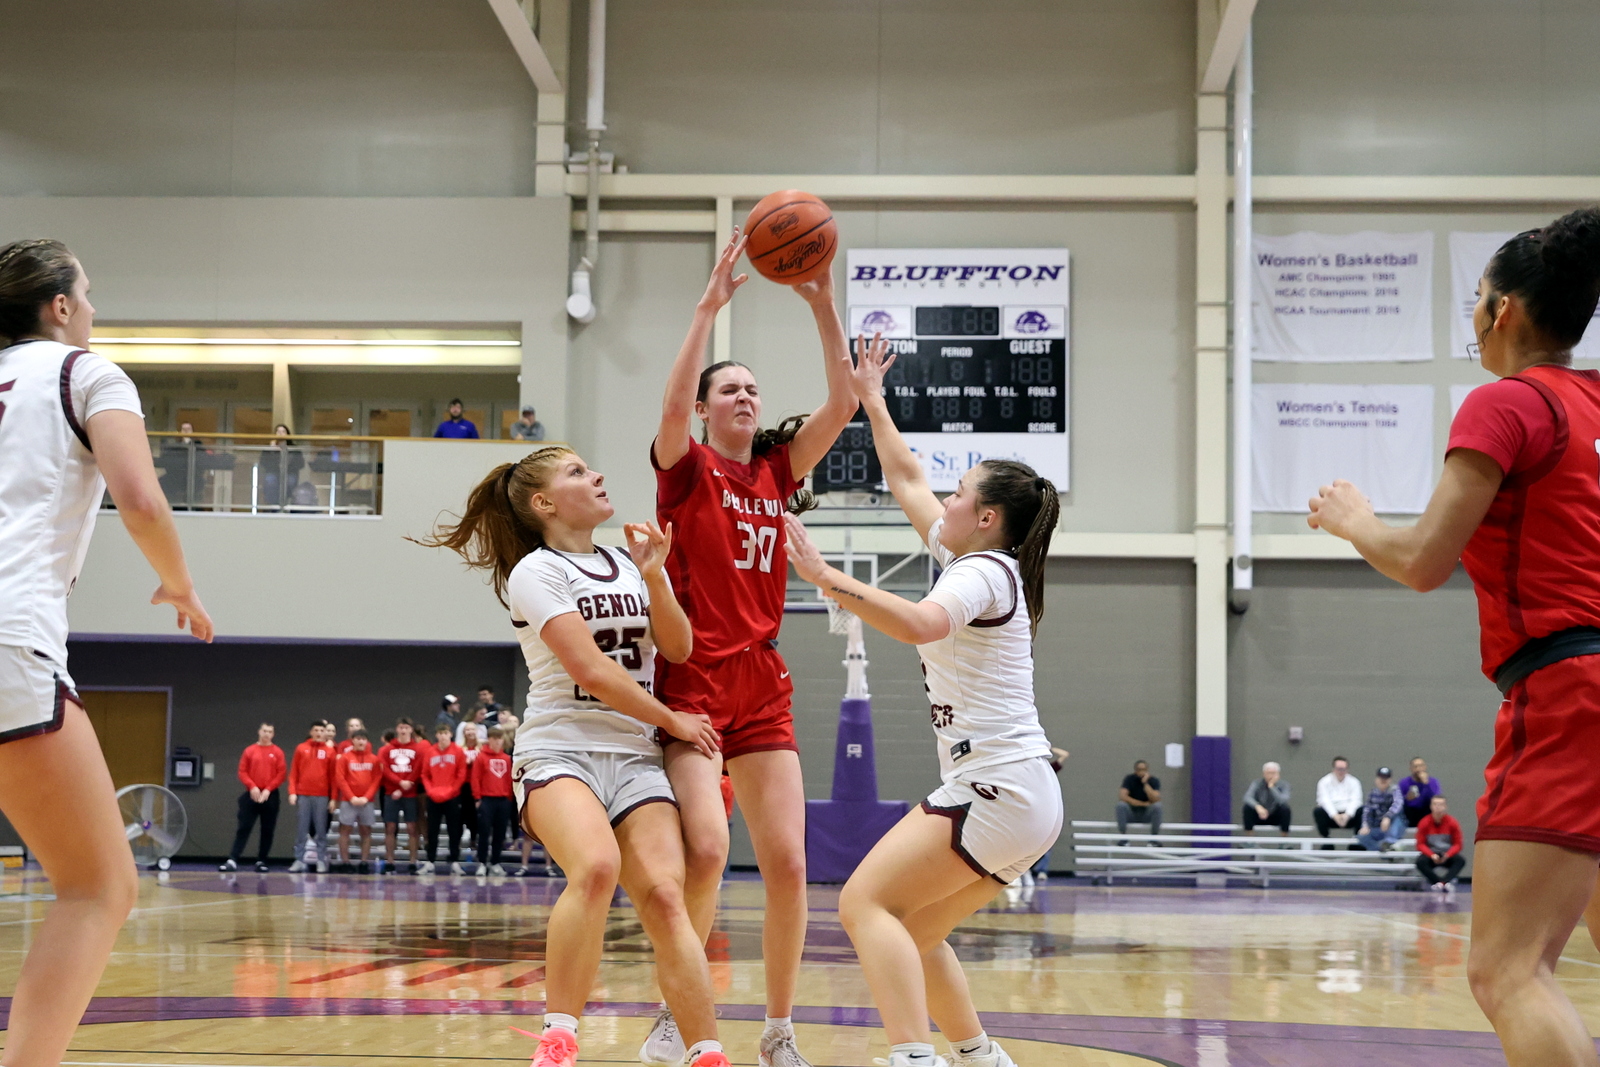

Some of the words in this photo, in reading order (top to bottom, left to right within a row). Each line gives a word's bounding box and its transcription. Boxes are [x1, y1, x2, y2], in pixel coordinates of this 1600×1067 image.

[1258, 253, 1330, 268] Women's
[1335, 253, 1418, 268] Basketball
[851, 265, 1065, 281] BLUFFTON
[854, 340, 917, 354] FTON
[941, 347, 973, 357] PERIOD
[1010, 340, 1053, 354] GUEST
[926, 386, 960, 397] PLAYER
[963, 386, 986, 397] FOUL
[1027, 386, 1057, 397] FOULS
[1277, 401, 1345, 413] Women's
[1350, 401, 1399, 413] Tennis
[942, 422, 973, 432] MATCH
[1028, 422, 1057, 432] SCORE
[733, 520, 777, 573] 30
[593, 626, 647, 671] 25
